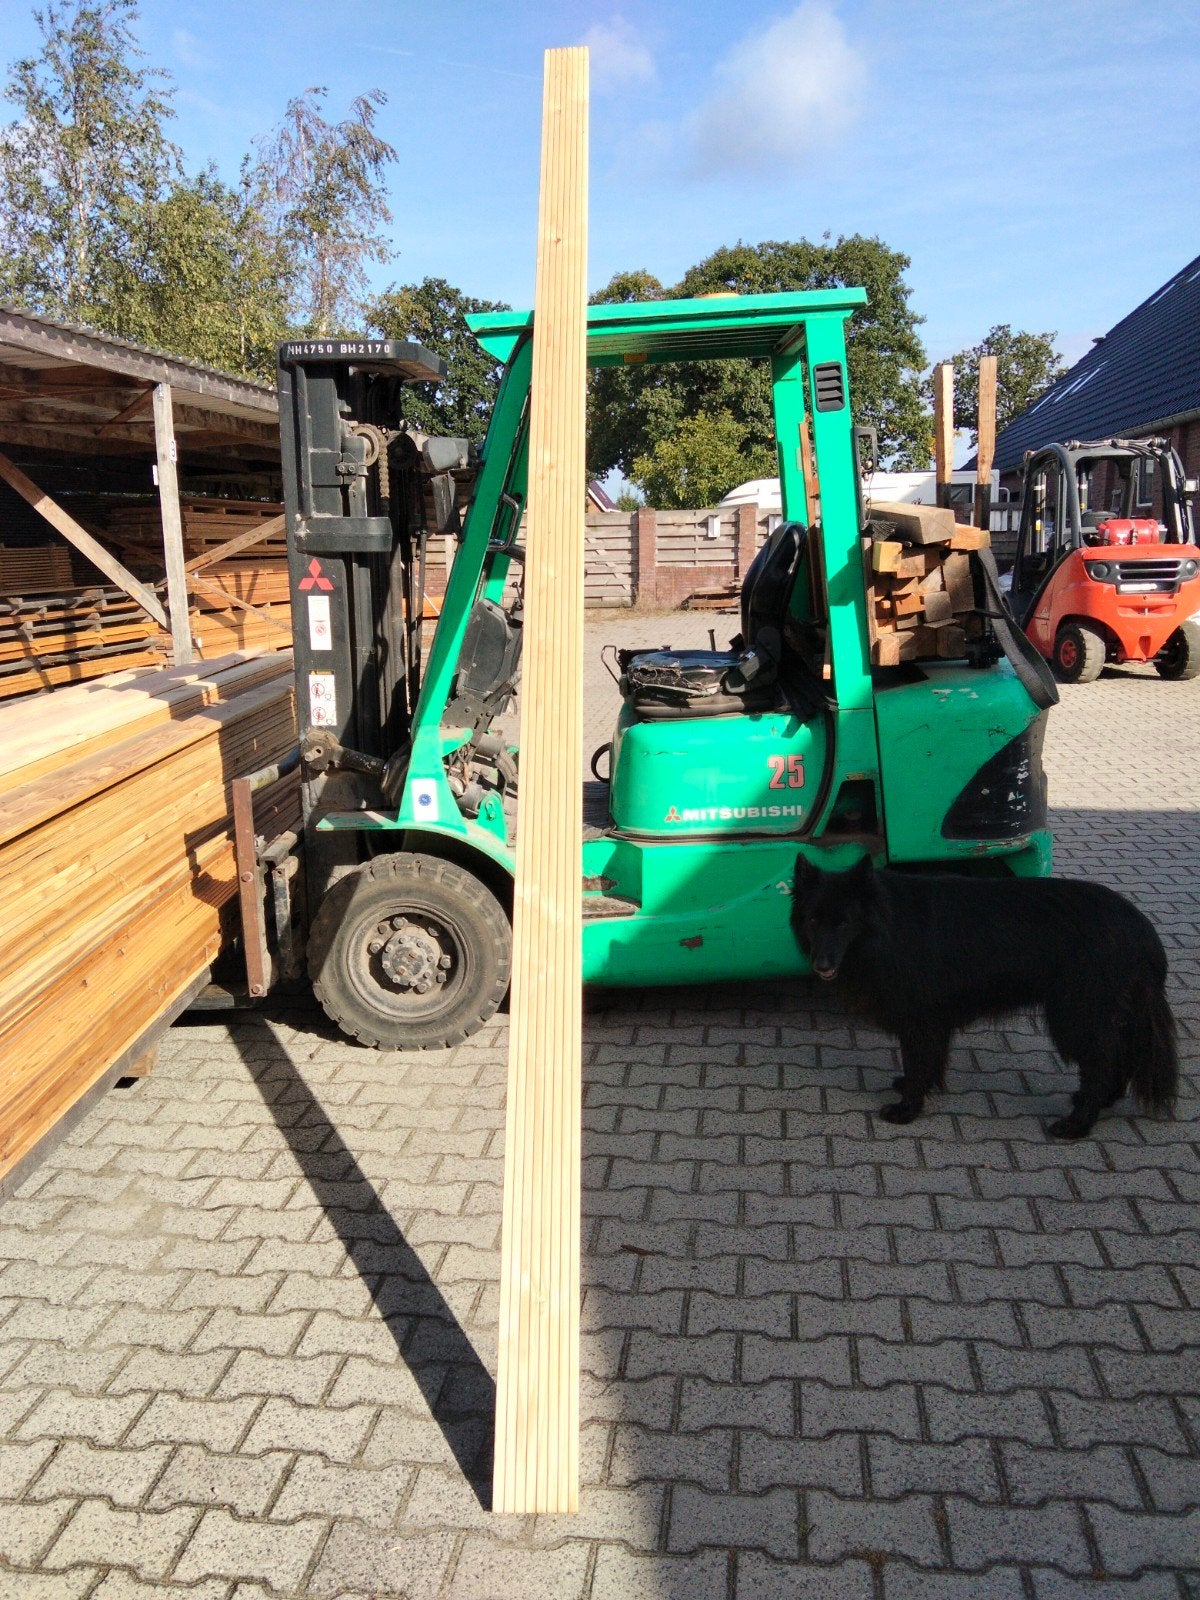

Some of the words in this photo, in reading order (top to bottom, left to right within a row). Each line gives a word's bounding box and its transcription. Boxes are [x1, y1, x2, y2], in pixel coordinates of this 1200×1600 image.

[340, 344, 390, 354] BH2170
[768, 754, 806, 790] 25
[681, 804, 803, 822] MITSUBISHI
